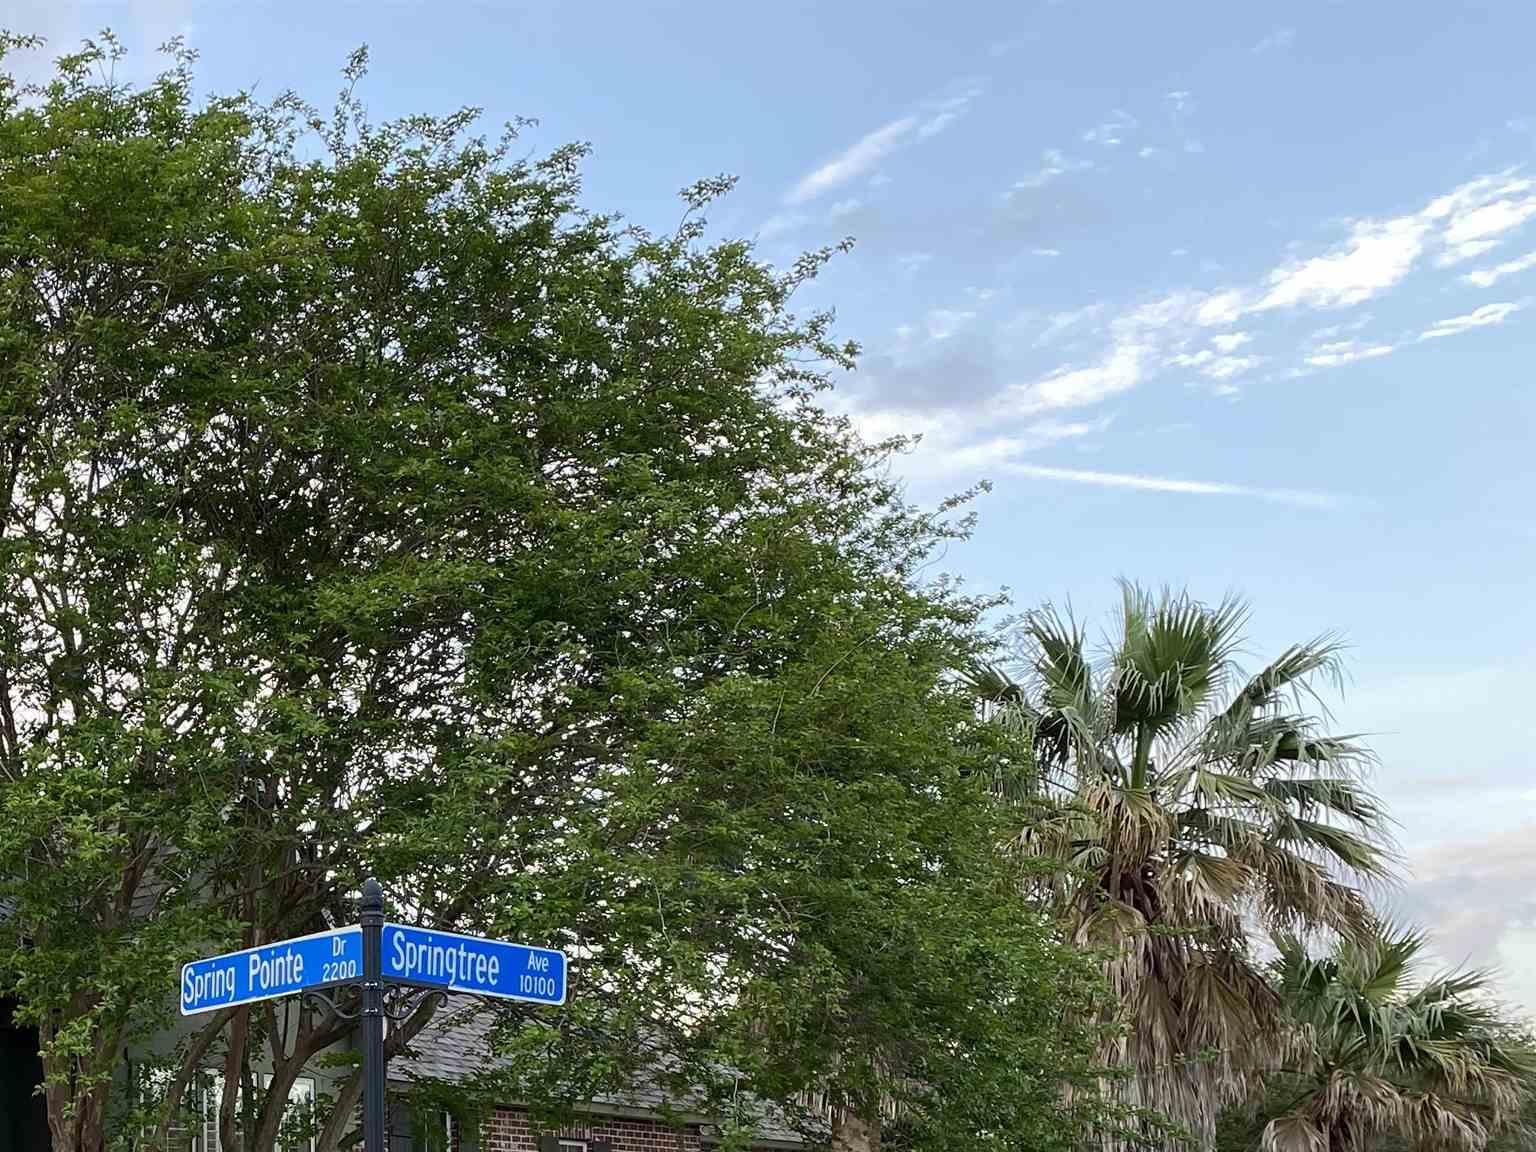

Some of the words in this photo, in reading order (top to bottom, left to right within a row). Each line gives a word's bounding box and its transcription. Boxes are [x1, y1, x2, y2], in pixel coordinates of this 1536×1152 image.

[332, 936, 347, 956] Dr
[391, 930, 499, 986] Springtree
[527, 951, 549, 972] Ave
[184, 963, 235, 1006] Spring
[248, 947, 303, 991] Pointe
[322, 959, 356, 982] 2200
[519, 974, 555, 996] 10100
